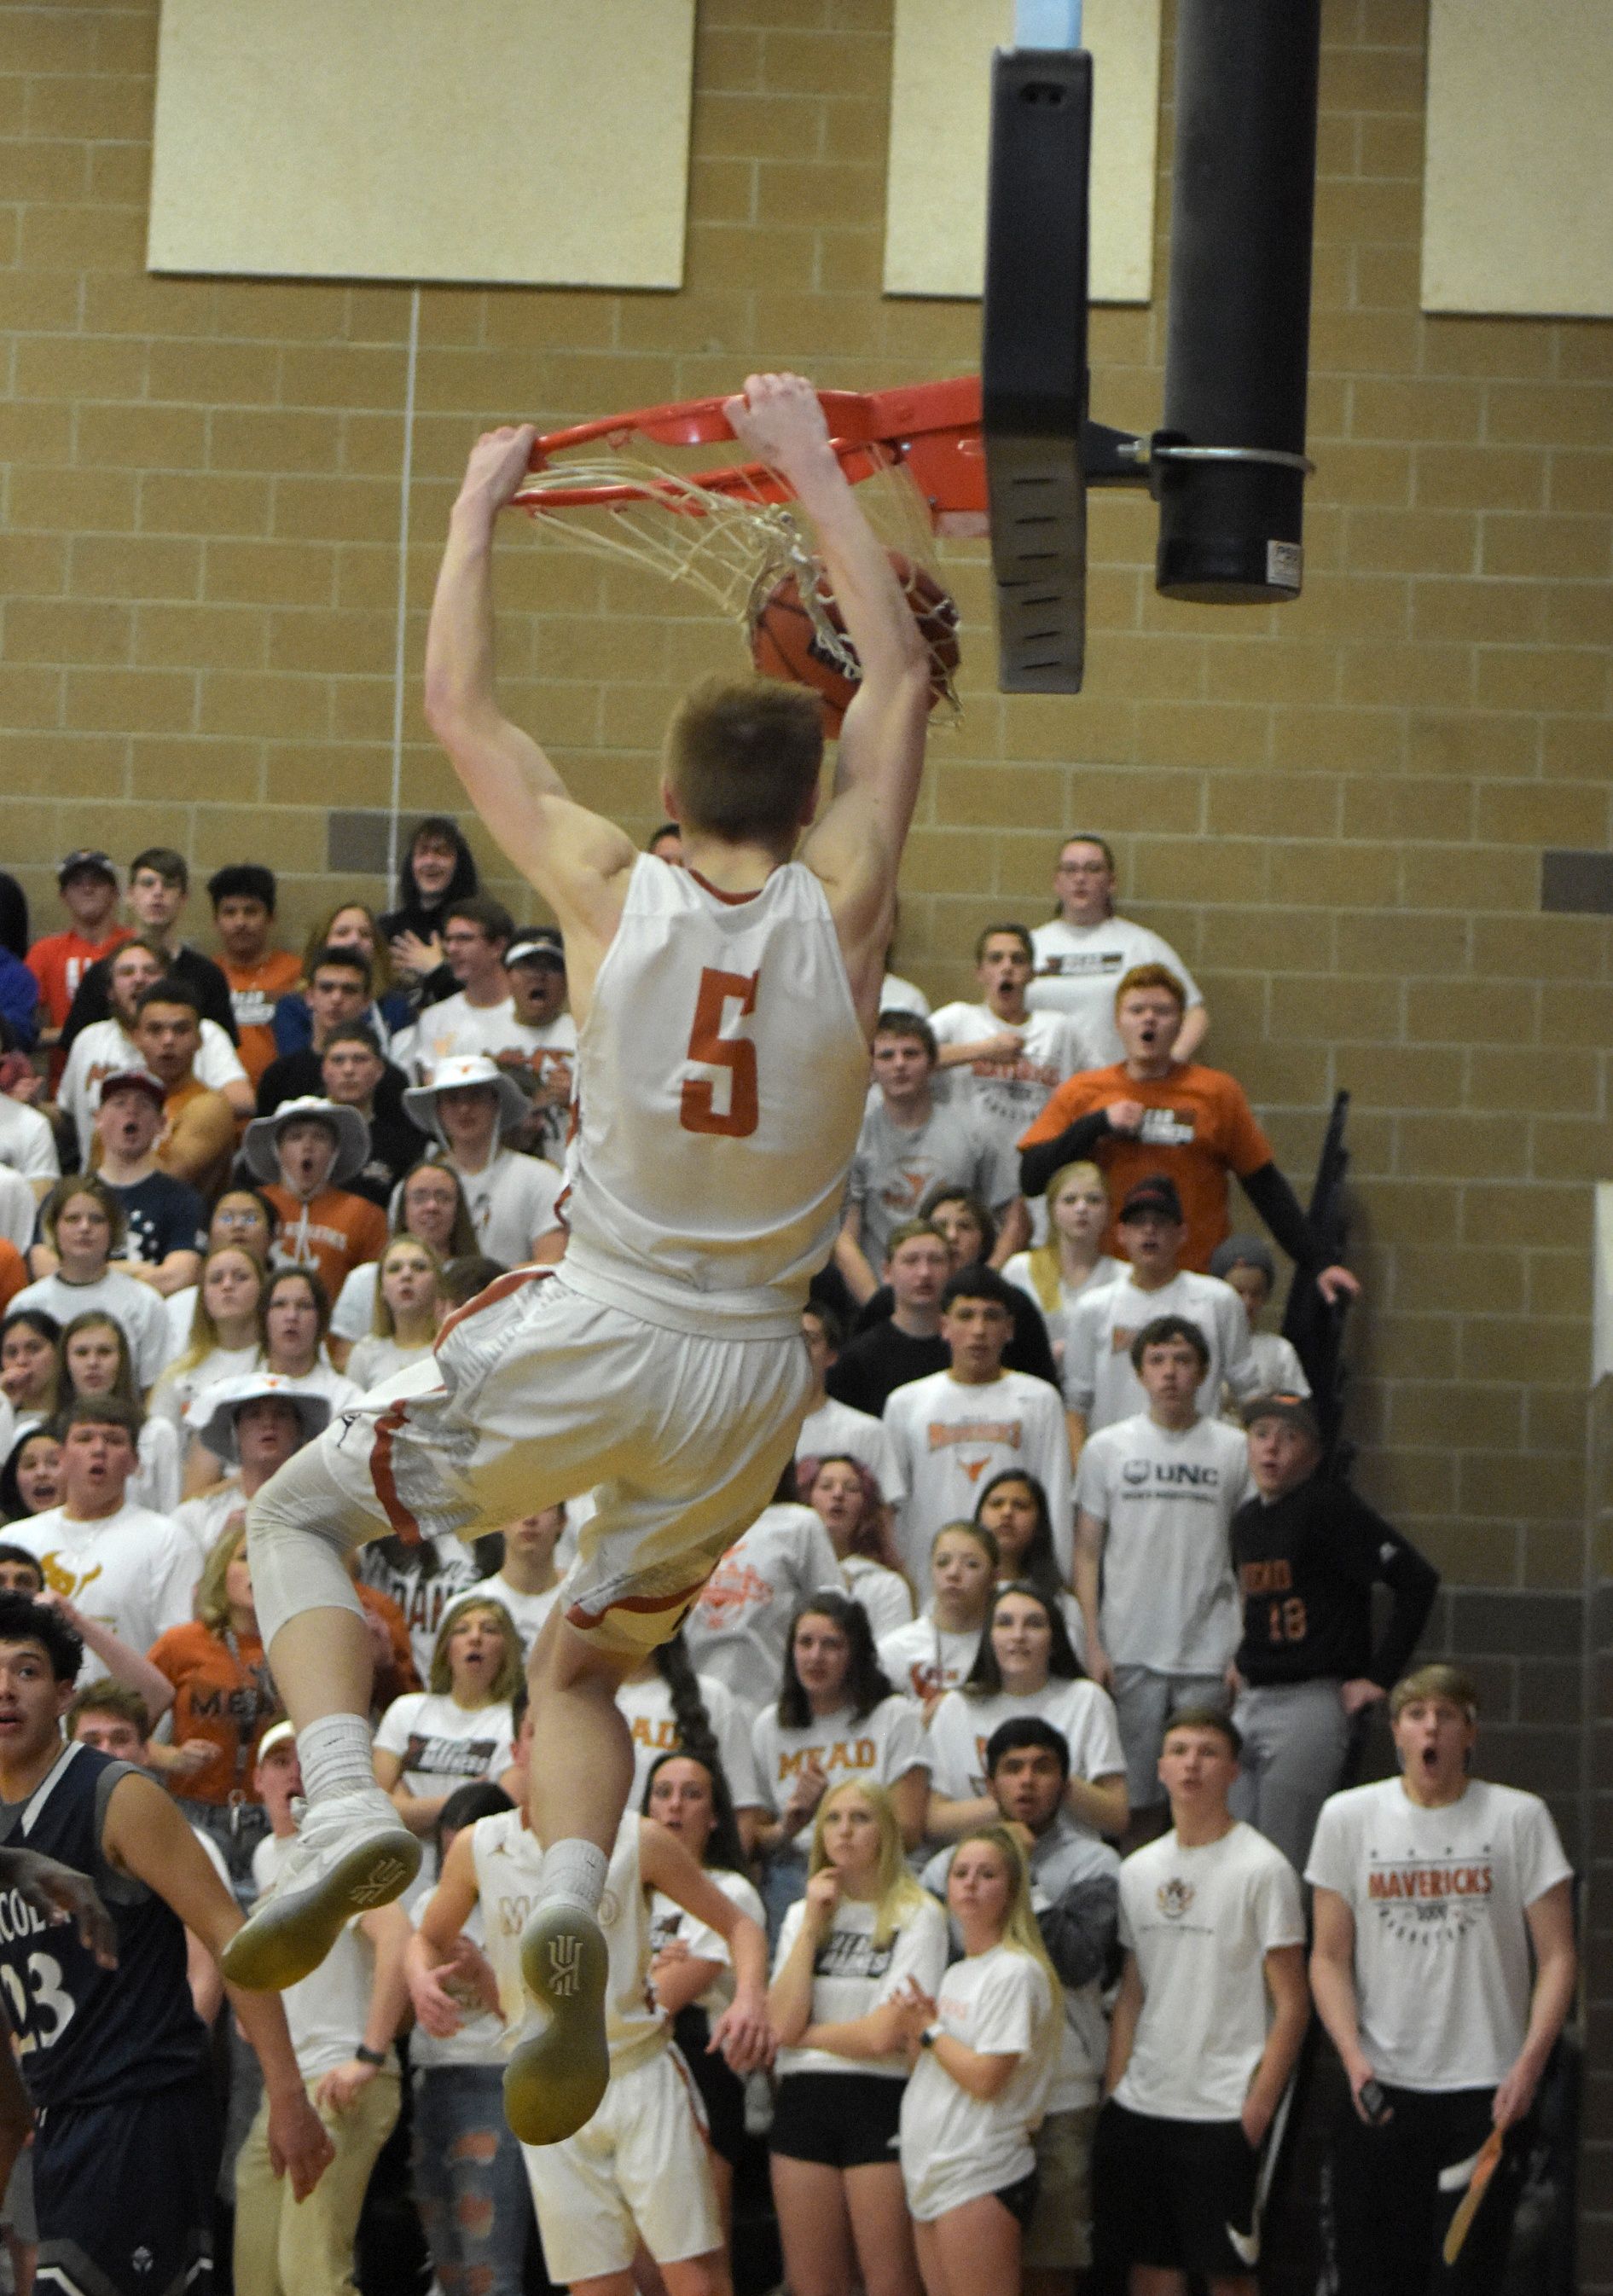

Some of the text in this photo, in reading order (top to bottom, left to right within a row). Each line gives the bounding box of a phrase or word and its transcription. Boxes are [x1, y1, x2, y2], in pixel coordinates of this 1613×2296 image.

[680, 966, 760, 1139] 5
[1155, 1463, 1219, 1486] UNC
[777, 1736, 878, 1782] MEAD
[1368, 1865, 1493, 1900] MAVERICKS
